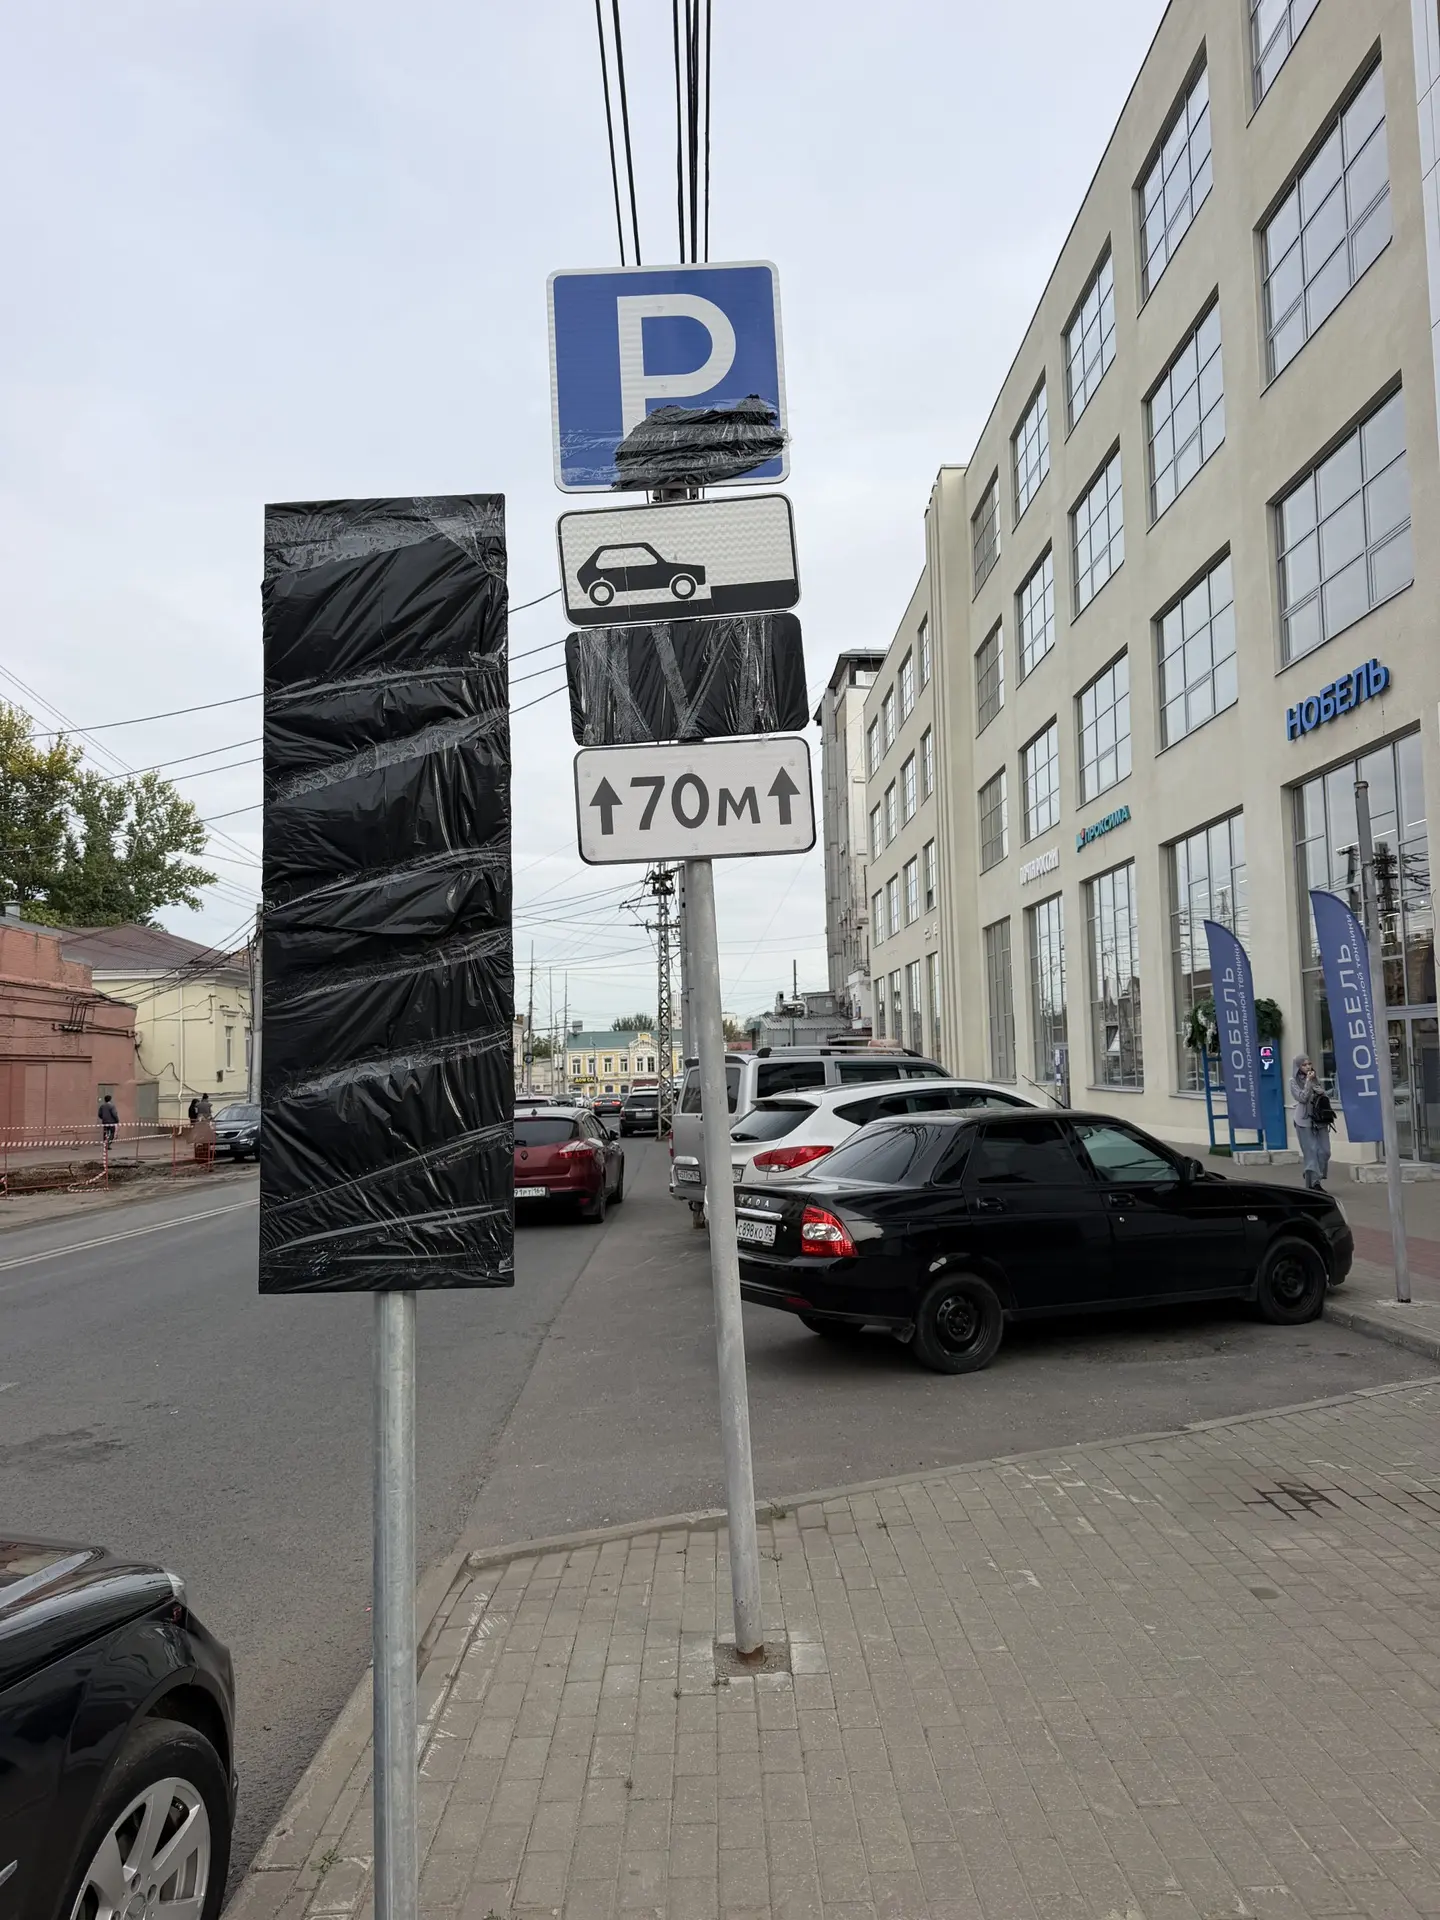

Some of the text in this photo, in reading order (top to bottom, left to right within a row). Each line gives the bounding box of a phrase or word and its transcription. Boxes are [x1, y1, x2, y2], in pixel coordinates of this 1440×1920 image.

[617, 293, 736, 440] P
[1287, 658, 1389, 741] НОБЕЛЬ
[1084, 805, 1131, 844] ПРОКСИМА
[1346, 914, 1361, 968] техники
[1222, 967, 1247, 1092] НОБЕЛЬ
[1234, 944, 1256, 1117] магазин премиальной техники
[1338, 944, 1377, 1096] НОБЕЛЬ
